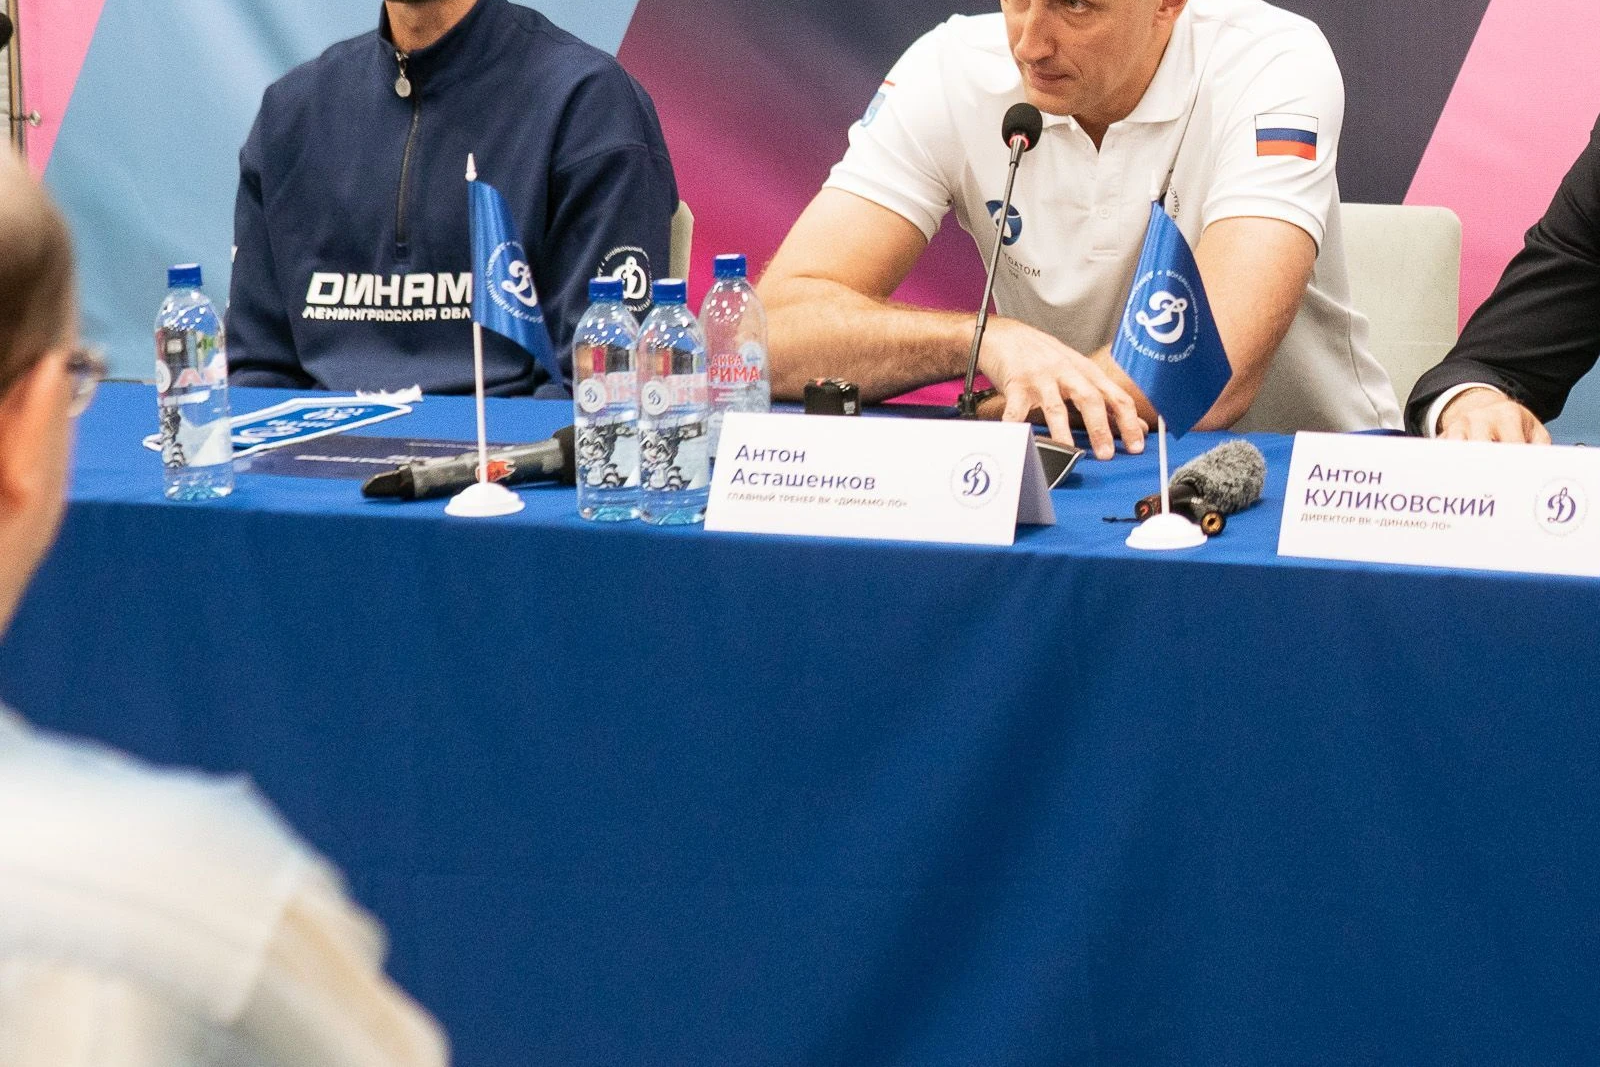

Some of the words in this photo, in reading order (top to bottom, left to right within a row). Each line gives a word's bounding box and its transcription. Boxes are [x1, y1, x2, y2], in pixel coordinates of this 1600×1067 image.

[305, 271, 474, 307] ДИНАМ
[708, 365, 761, 383] РИМА
[734, 444, 806, 463] Антон
[730, 467, 877, 491] Асташенков
[1308, 464, 1383, 485] Антон
[1304, 488, 1497, 518] КУЛИКОВСКИЙ
[1300, 513, 1356, 524] ДИРЕКТОР
